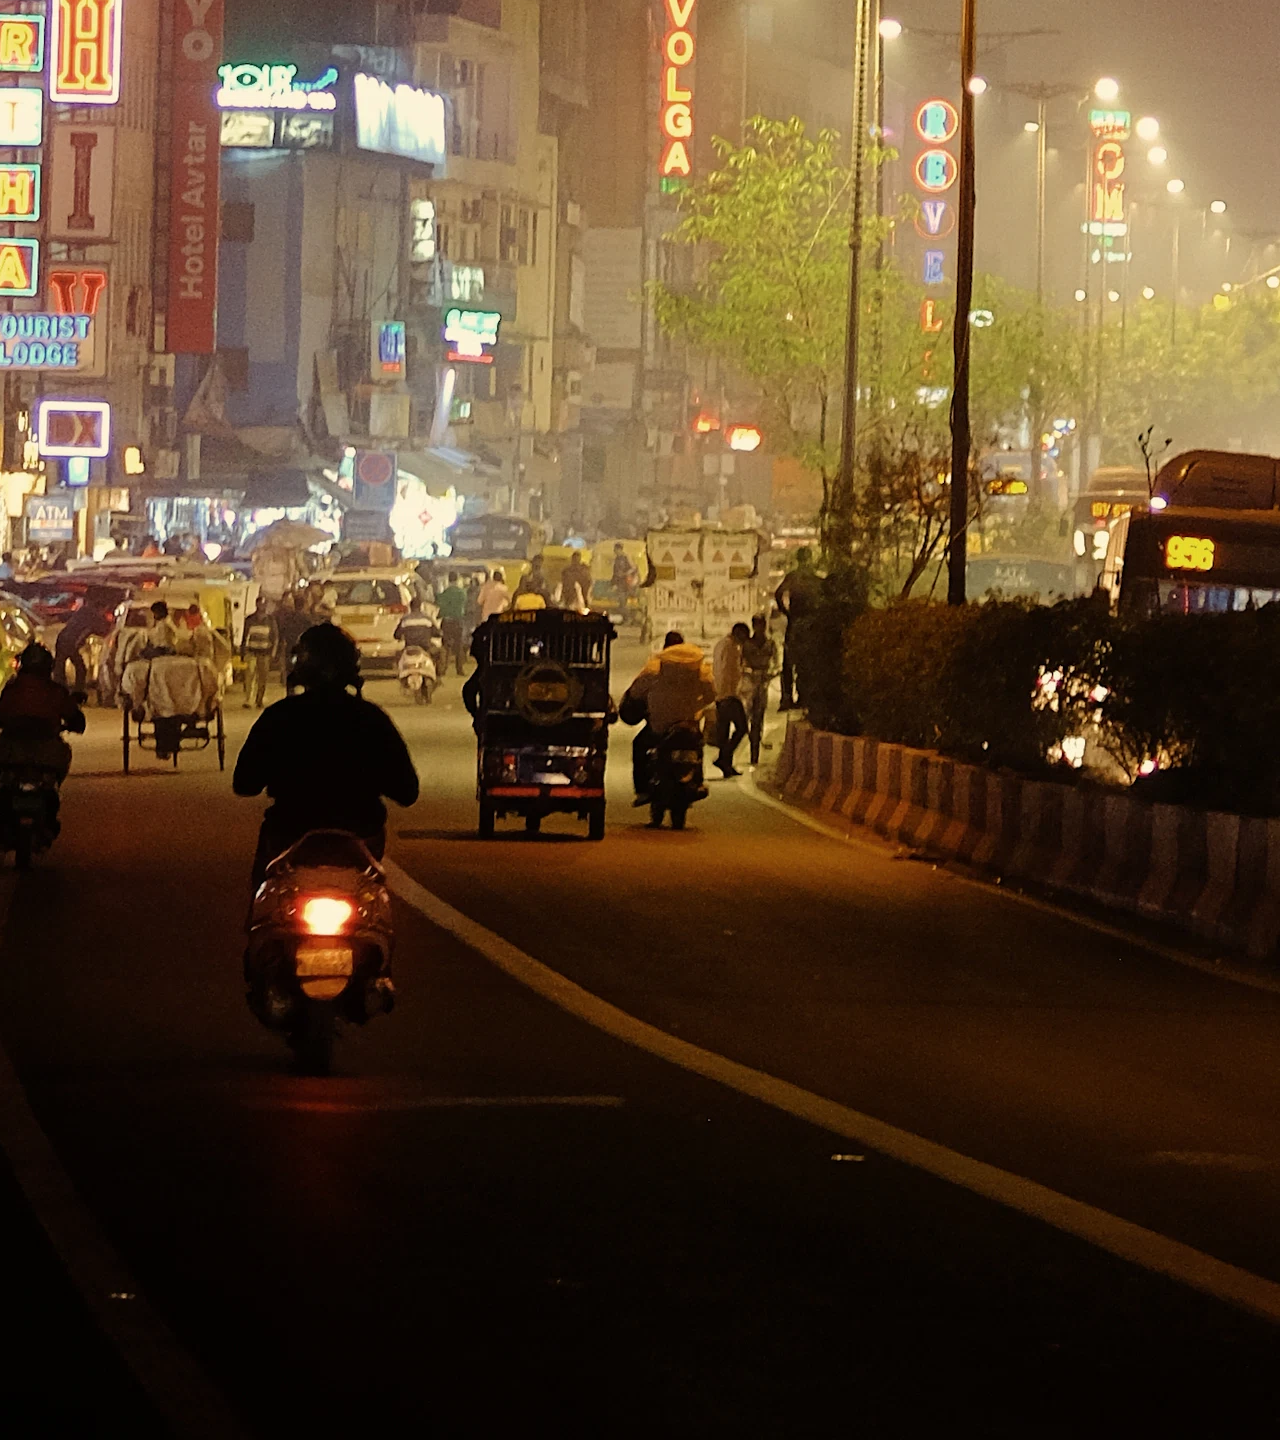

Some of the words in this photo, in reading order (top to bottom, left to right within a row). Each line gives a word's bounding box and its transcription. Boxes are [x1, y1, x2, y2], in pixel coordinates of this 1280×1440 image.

[181, 120, 207, 207] Avtar
[179, 208, 205, 301] Hotel
[35, 505, 69, 521] ATM
[1165, 536, 1215, 572] 956
